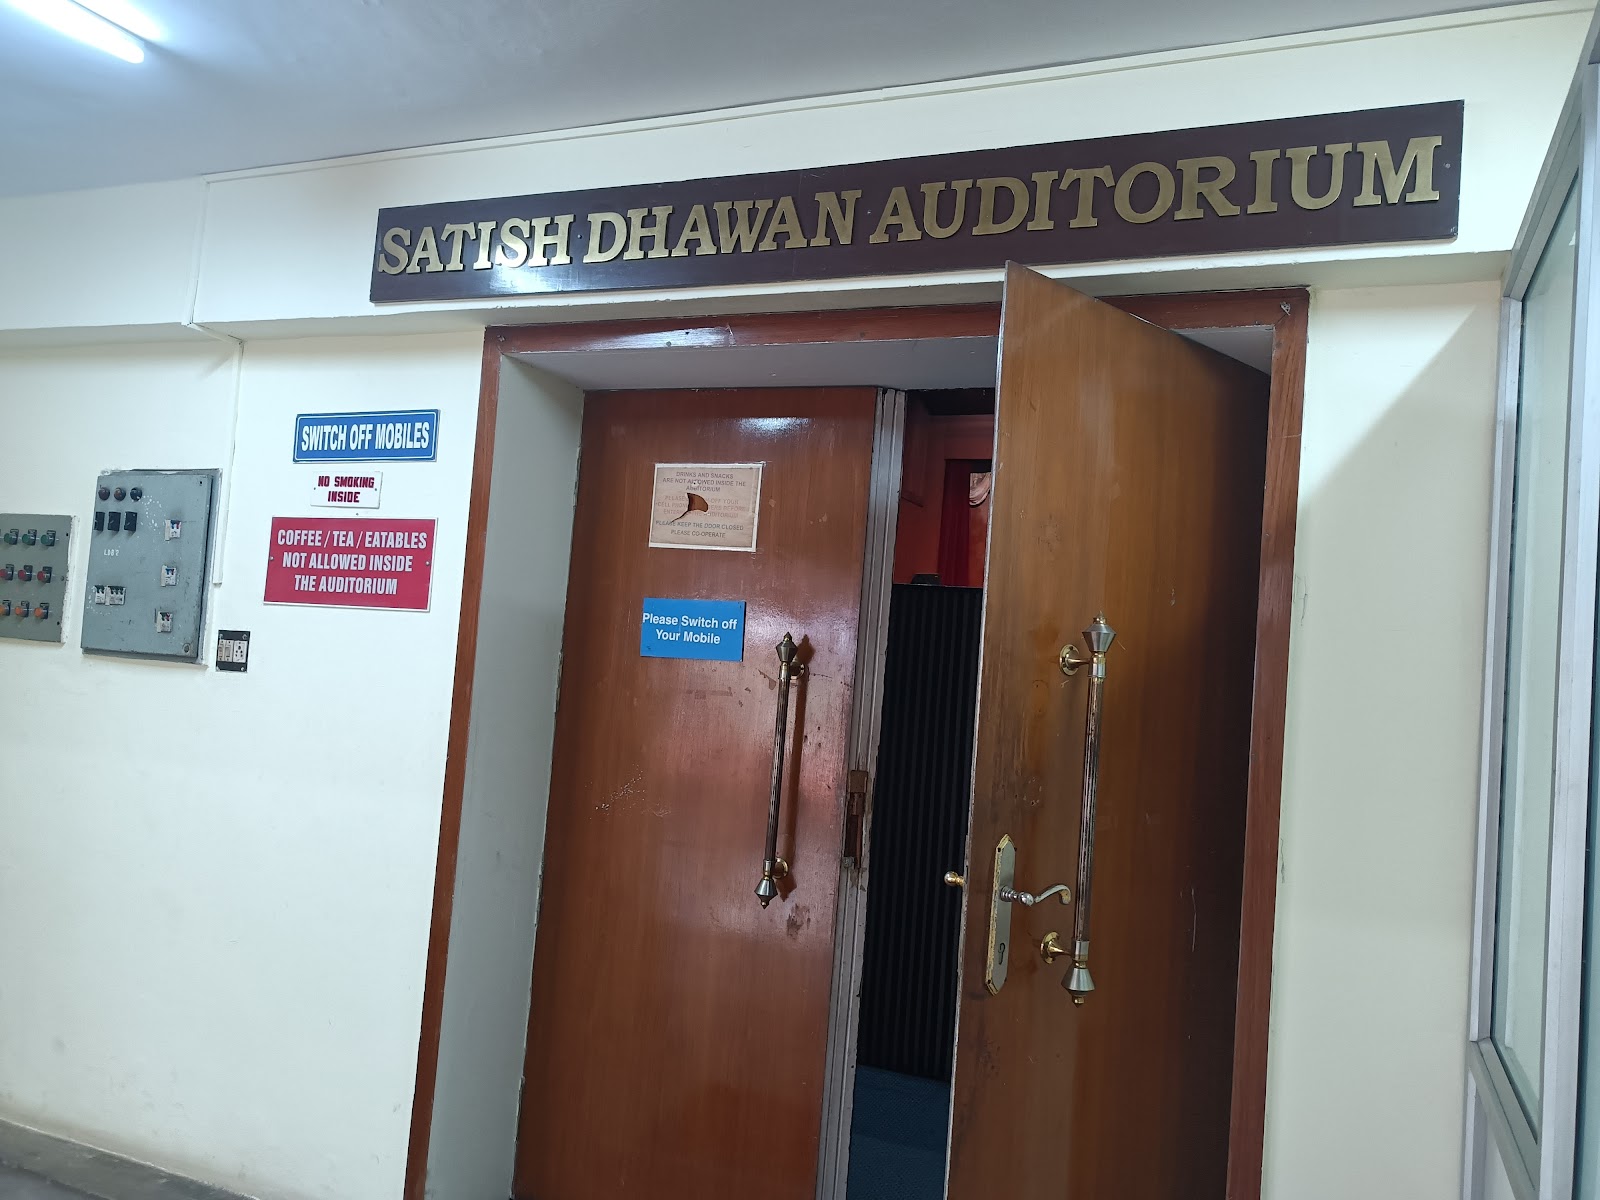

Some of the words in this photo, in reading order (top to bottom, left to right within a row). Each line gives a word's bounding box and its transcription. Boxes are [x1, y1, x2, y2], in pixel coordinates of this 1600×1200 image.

[378, 213, 578, 276] SATISH
[582, 189, 862, 264] DHAWAN
[868, 135, 1443, 244] AUDITORIUM
[301, 424, 347, 451] SWITCH
[349, 423, 374, 451] OFF
[374, 421, 430, 450] MOBILES
[317, 475, 330, 487] NO
[334, 476, 375, 488] SMOKING
[327, 490, 361, 503] INSIDE
[277, 529, 323, 547] COFFEE
[332, 531, 354, 547] TEA
[364, 531, 428, 549] EATABLES
[691, 530, 726, 538] CO-OPERATE
[282, 551, 308, 568] NOT
[308, 552, 367, 571] ALLOWED
[368, 554, 414, 572] INSIDE
[294, 574, 317, 592] THE
[318, 575, 398, 595] AUDITORIUM
[642, 612, 679, 626] Please
[681, 615, 719, 629] Switch
[721, 618, 738, 630] off
[655, 628, 681, 641] Your
[683, 630, 721, 644] Mobile
